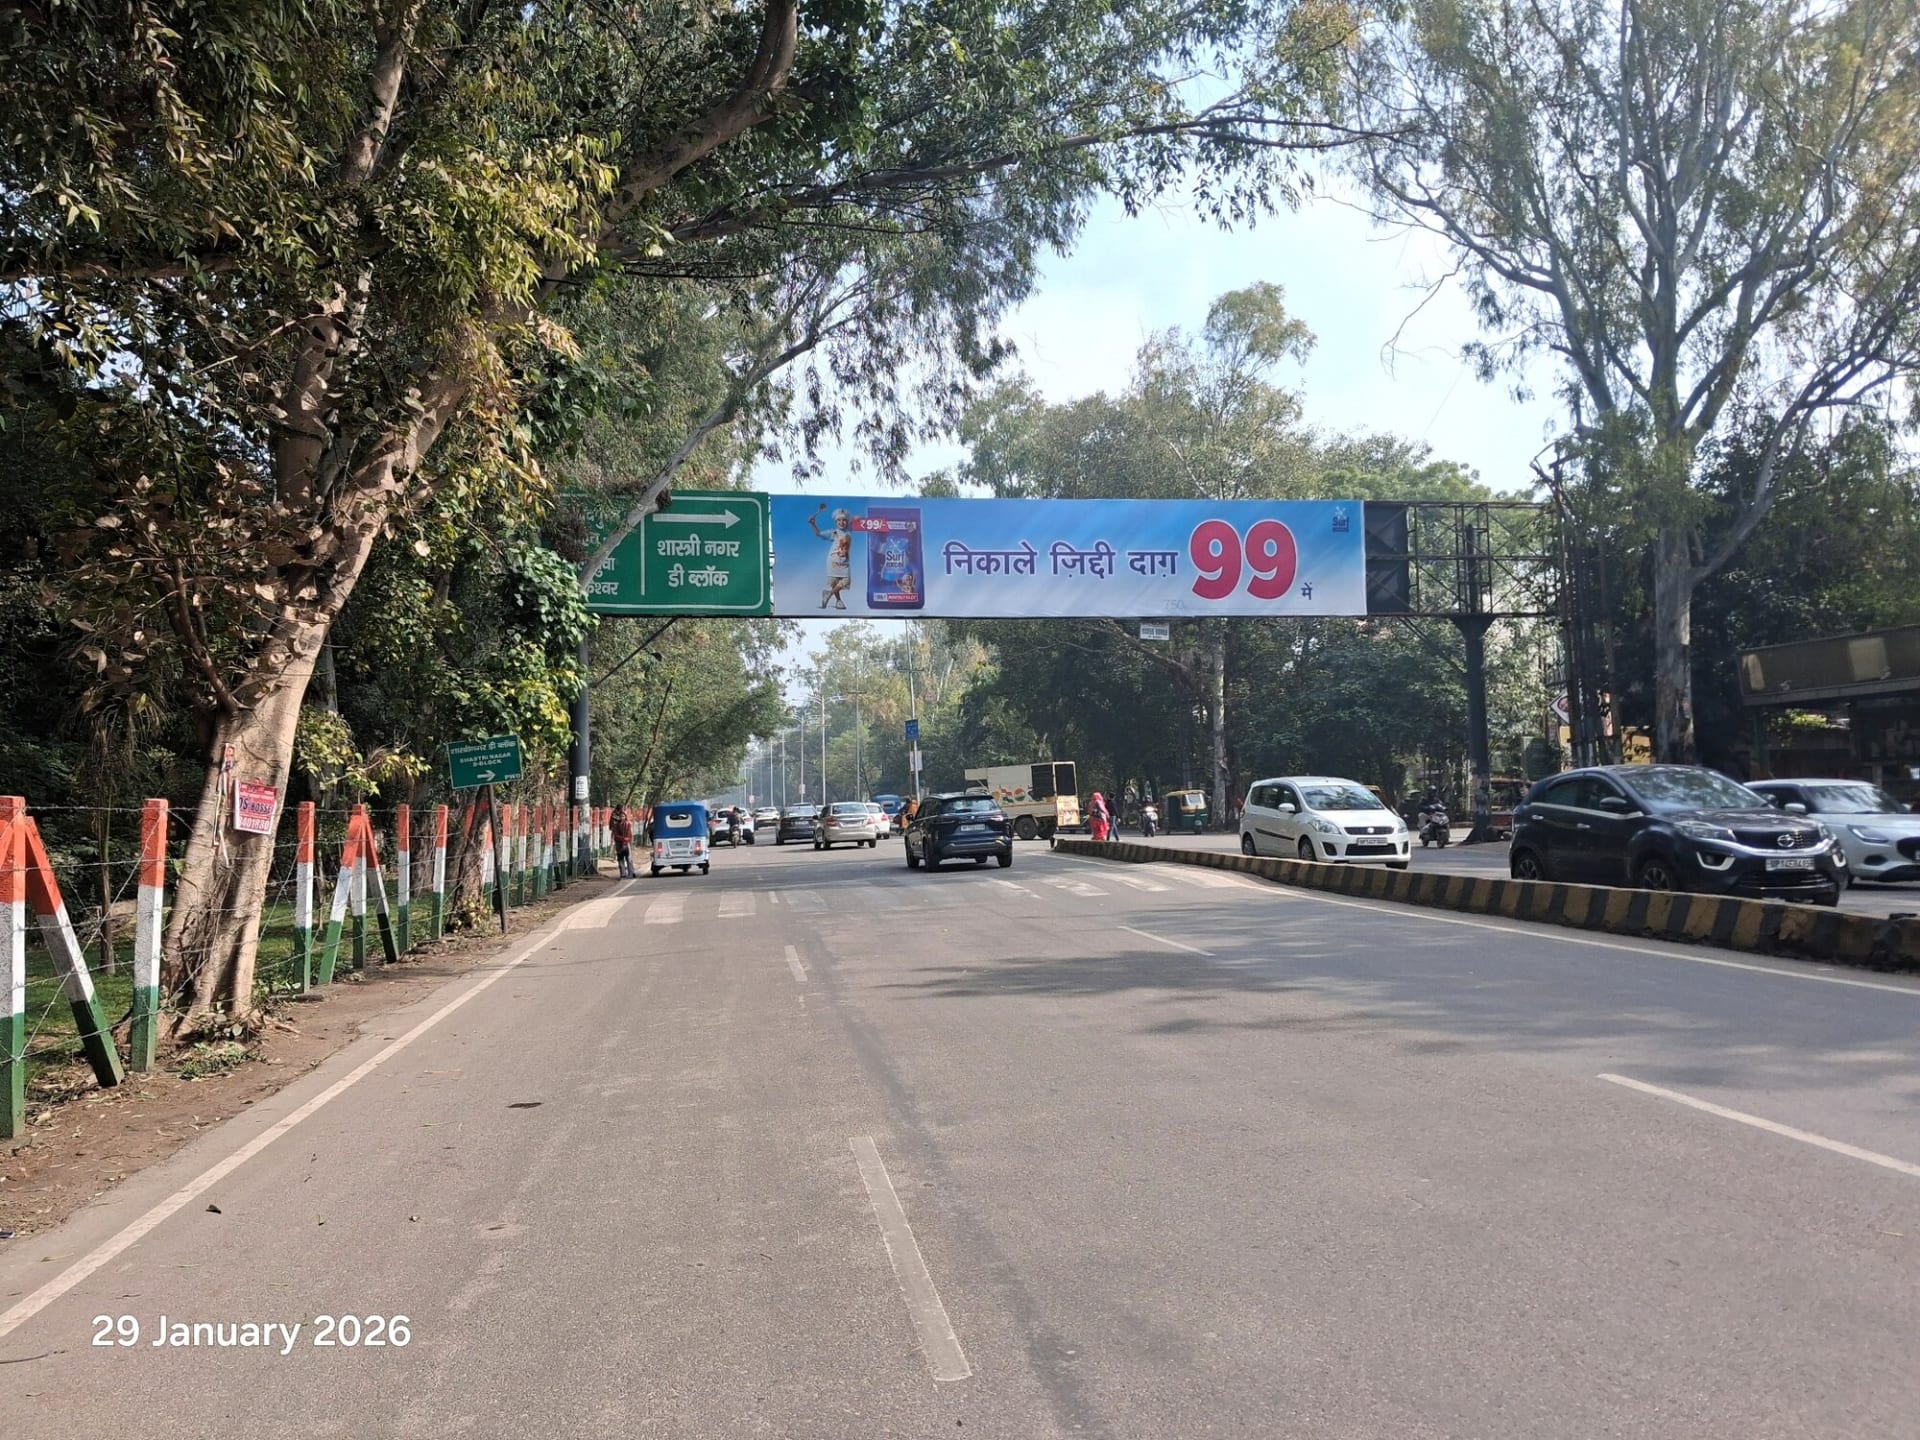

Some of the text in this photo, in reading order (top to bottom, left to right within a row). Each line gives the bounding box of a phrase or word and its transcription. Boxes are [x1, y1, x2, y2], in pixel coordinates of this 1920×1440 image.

[657, 533, 741, 557] शास्त्री नगर
[886, 550, 905, 562] Surf
[943, 518, 1314, 601] निकाले ज़िद्दी दाग़ 99 में
[668, 563, 730, 588] डी ब्लॉक
